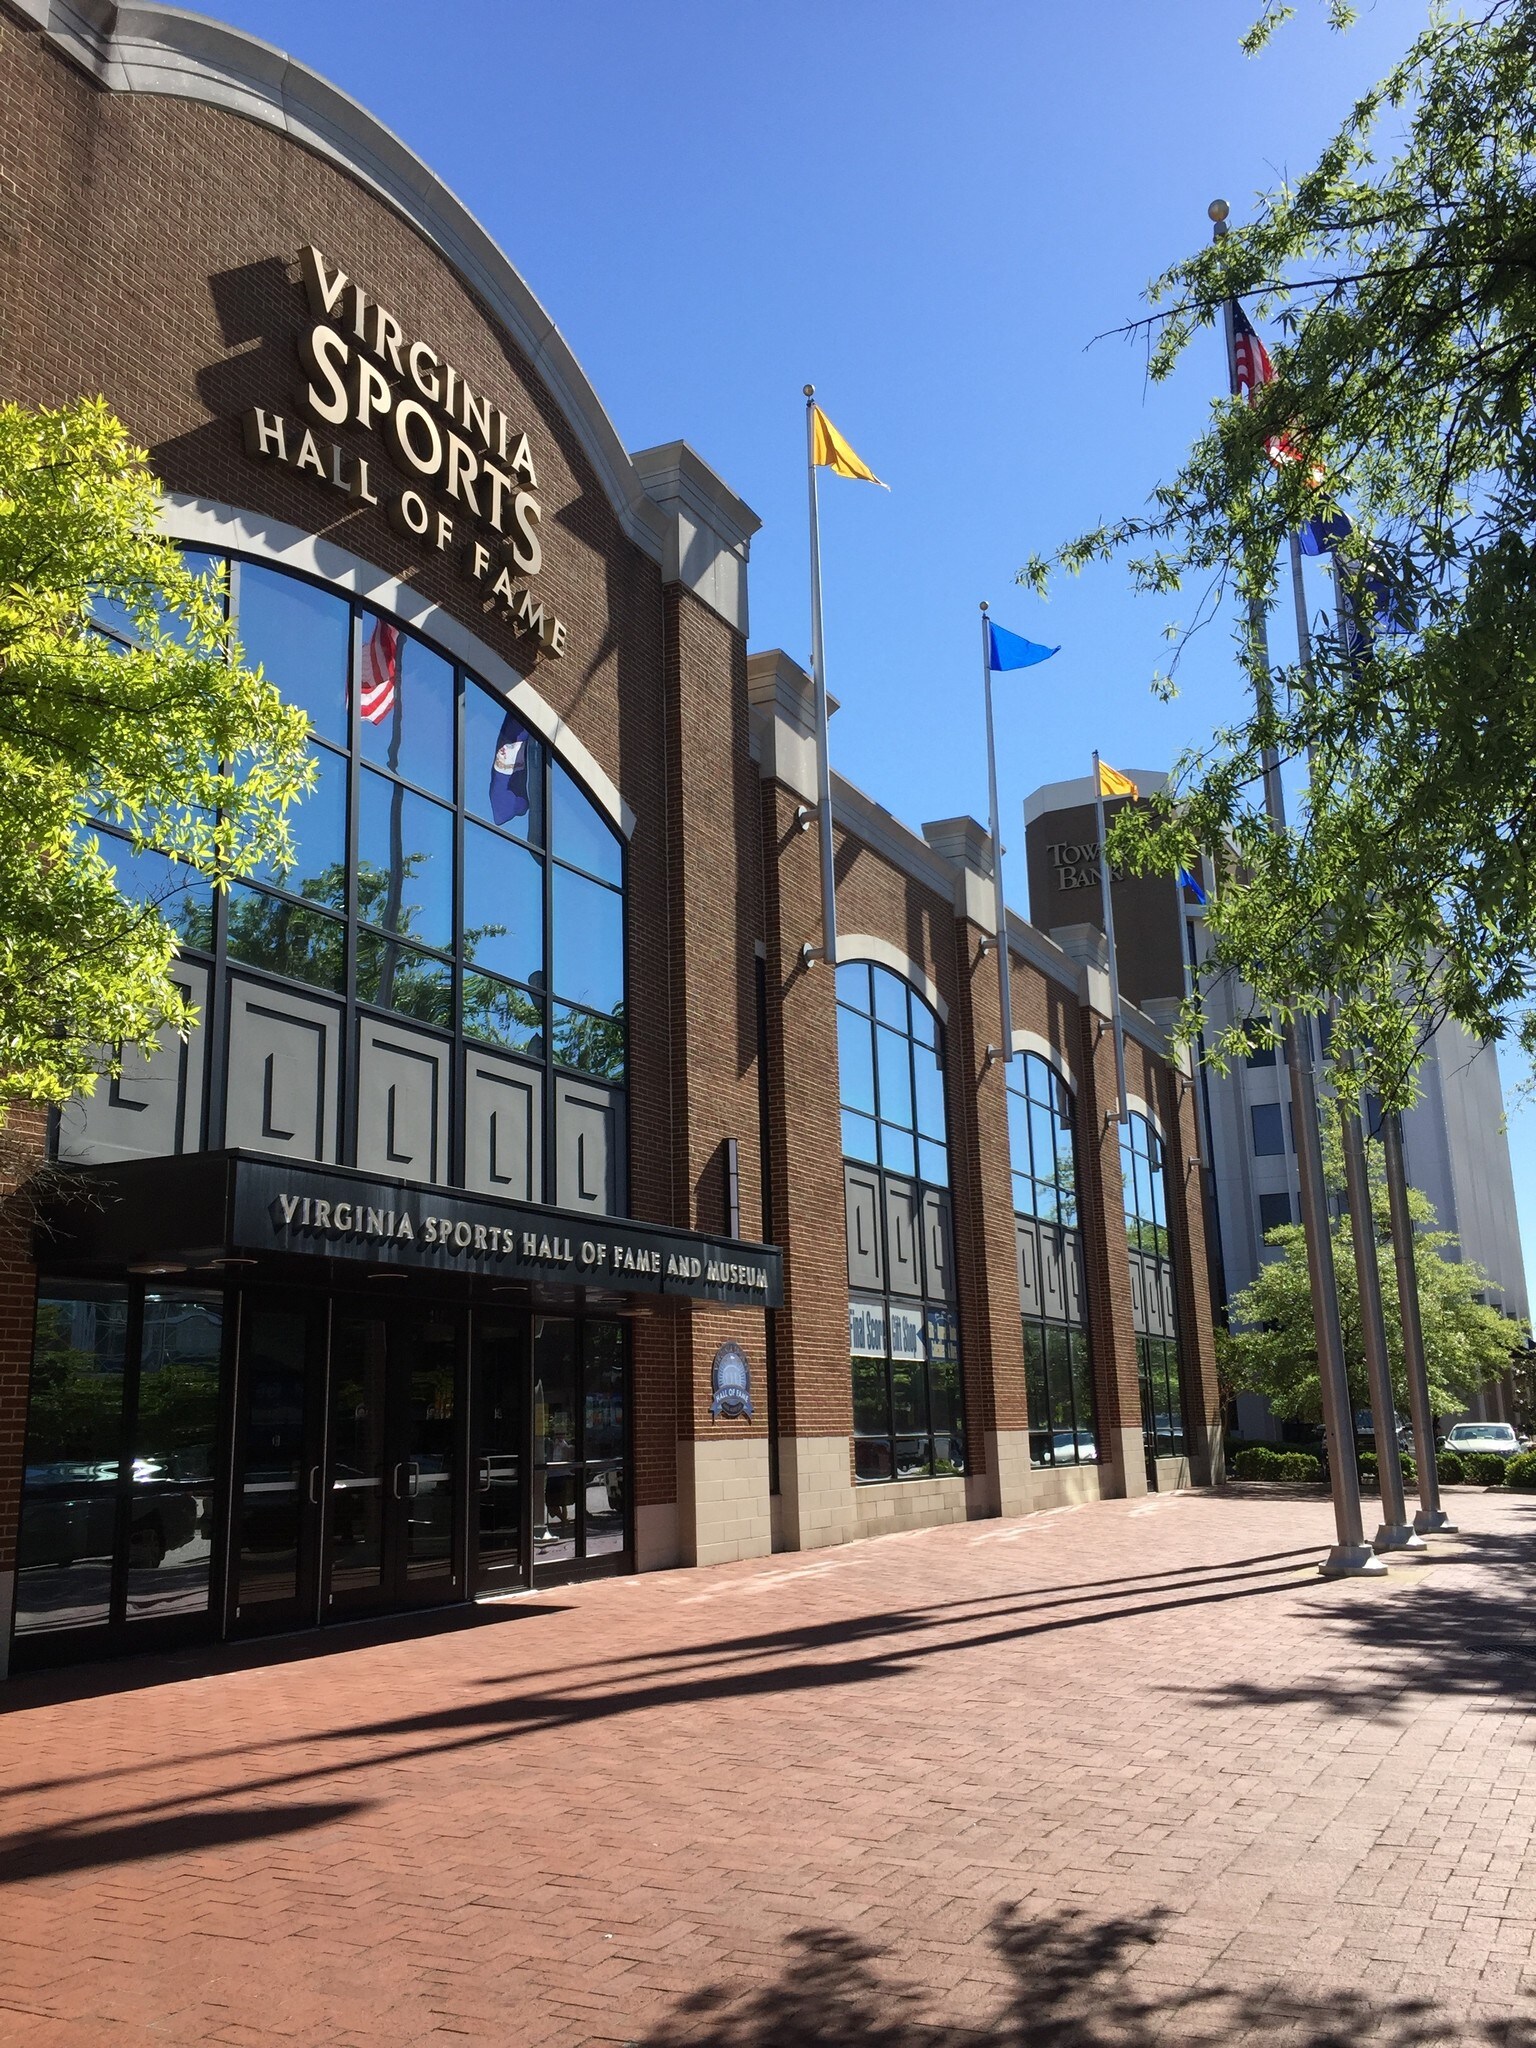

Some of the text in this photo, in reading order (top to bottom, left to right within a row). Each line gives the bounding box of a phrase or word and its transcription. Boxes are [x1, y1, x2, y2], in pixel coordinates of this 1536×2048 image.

[303, 245, 539, 490] VIRGINIA
[308, 325, 542, 576] SPORTS
[252, 406, 568, 659] HALL OF FAME
[1046, 841, 1099, 867] TOW
[278, 1193, 769, 1288] VIRGINIA SPORTS HALL OF FAME AND MUSEUM
[716, 1388, 749, 1403] HALL OF FAME
